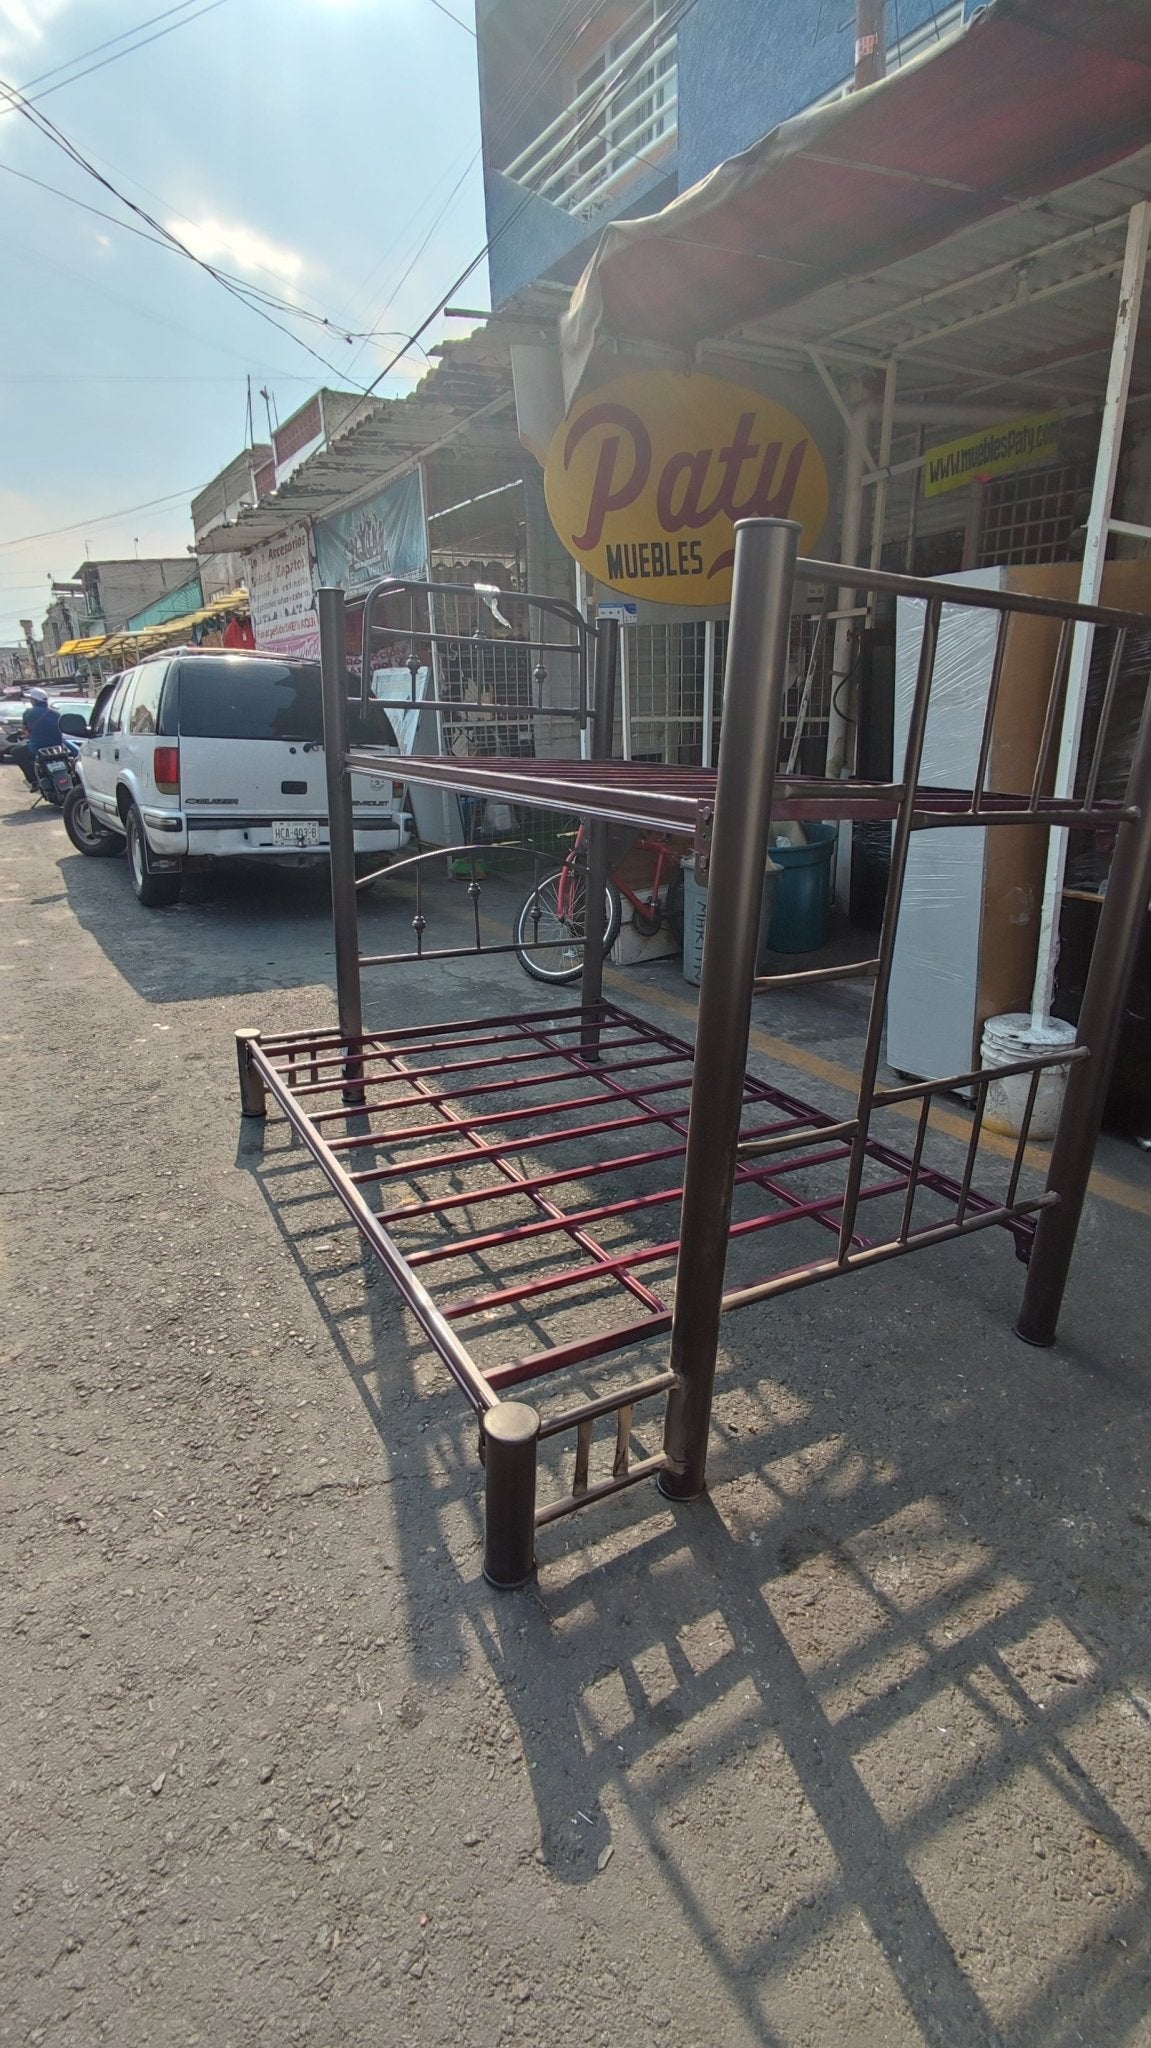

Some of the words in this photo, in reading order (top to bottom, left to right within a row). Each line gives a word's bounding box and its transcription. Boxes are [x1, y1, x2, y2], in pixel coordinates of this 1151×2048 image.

[564, 403, 808, 579] Paty
[268, 534, 306, 560] Accesorios
[605, 540, 704, 580] MUEBLES
